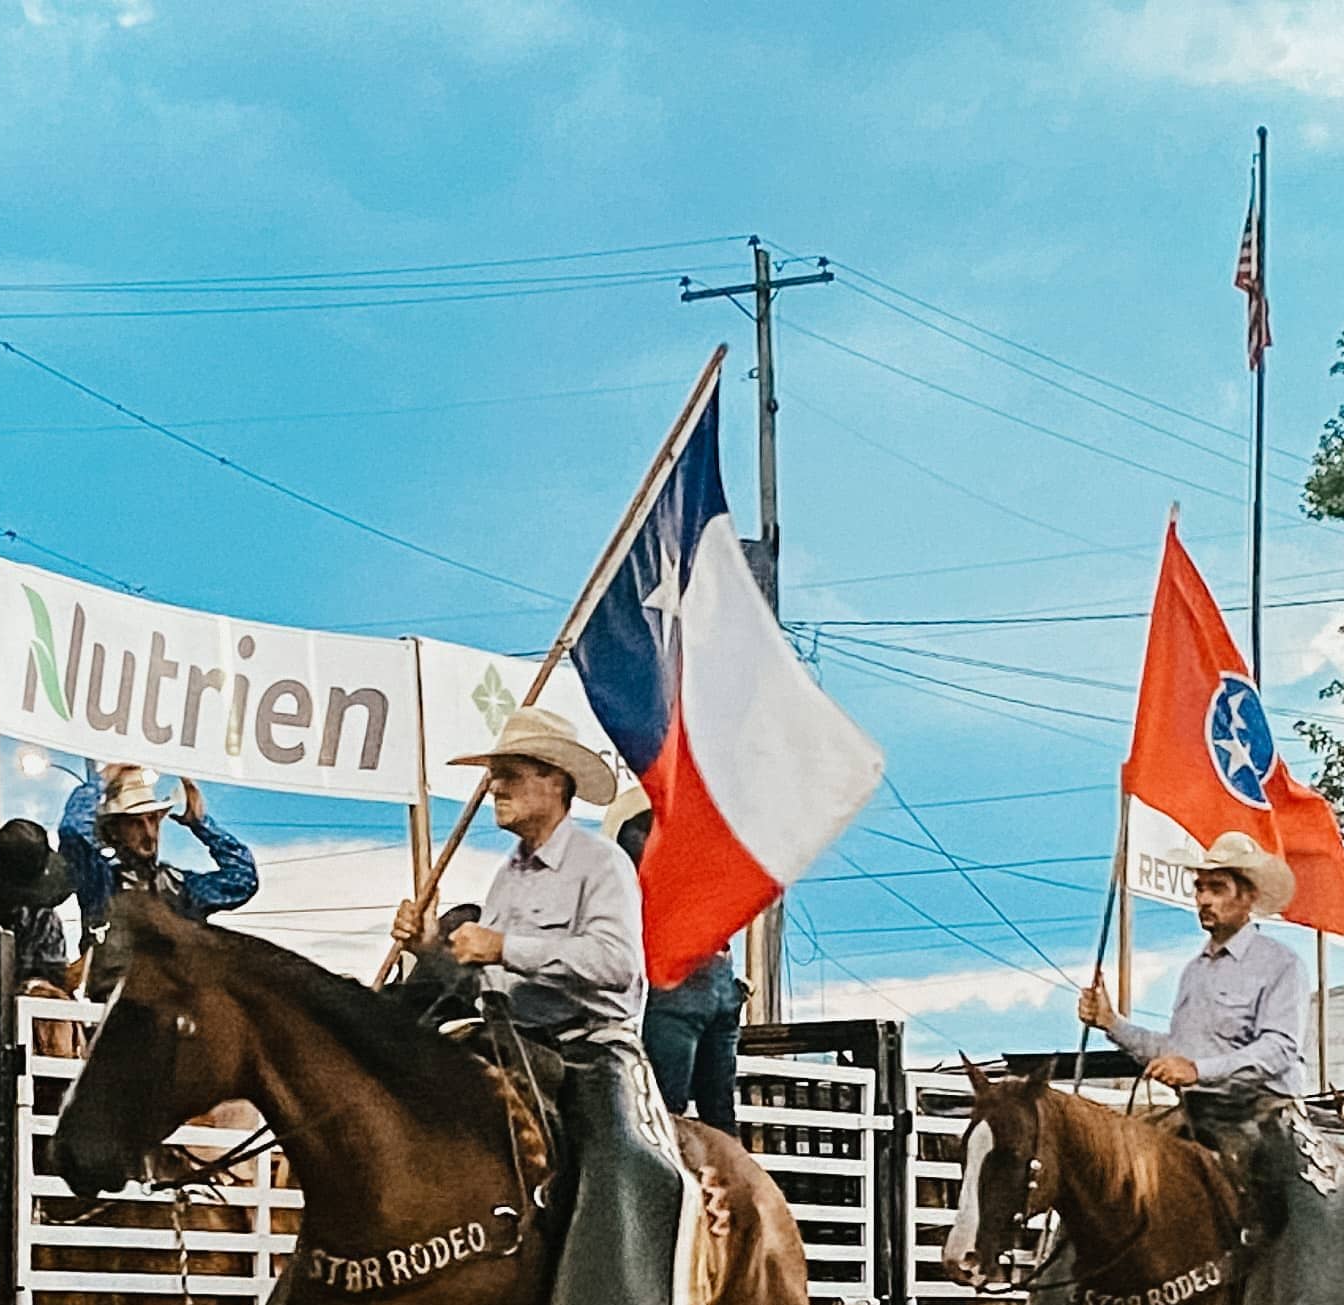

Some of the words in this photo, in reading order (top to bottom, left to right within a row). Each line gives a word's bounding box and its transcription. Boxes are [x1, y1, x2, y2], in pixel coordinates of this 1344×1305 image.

[22, 583, 390, 771] Nutrien
[309, 1249, 385, 1294] STAR
[386, 1221, 487, 1286] RODEO
